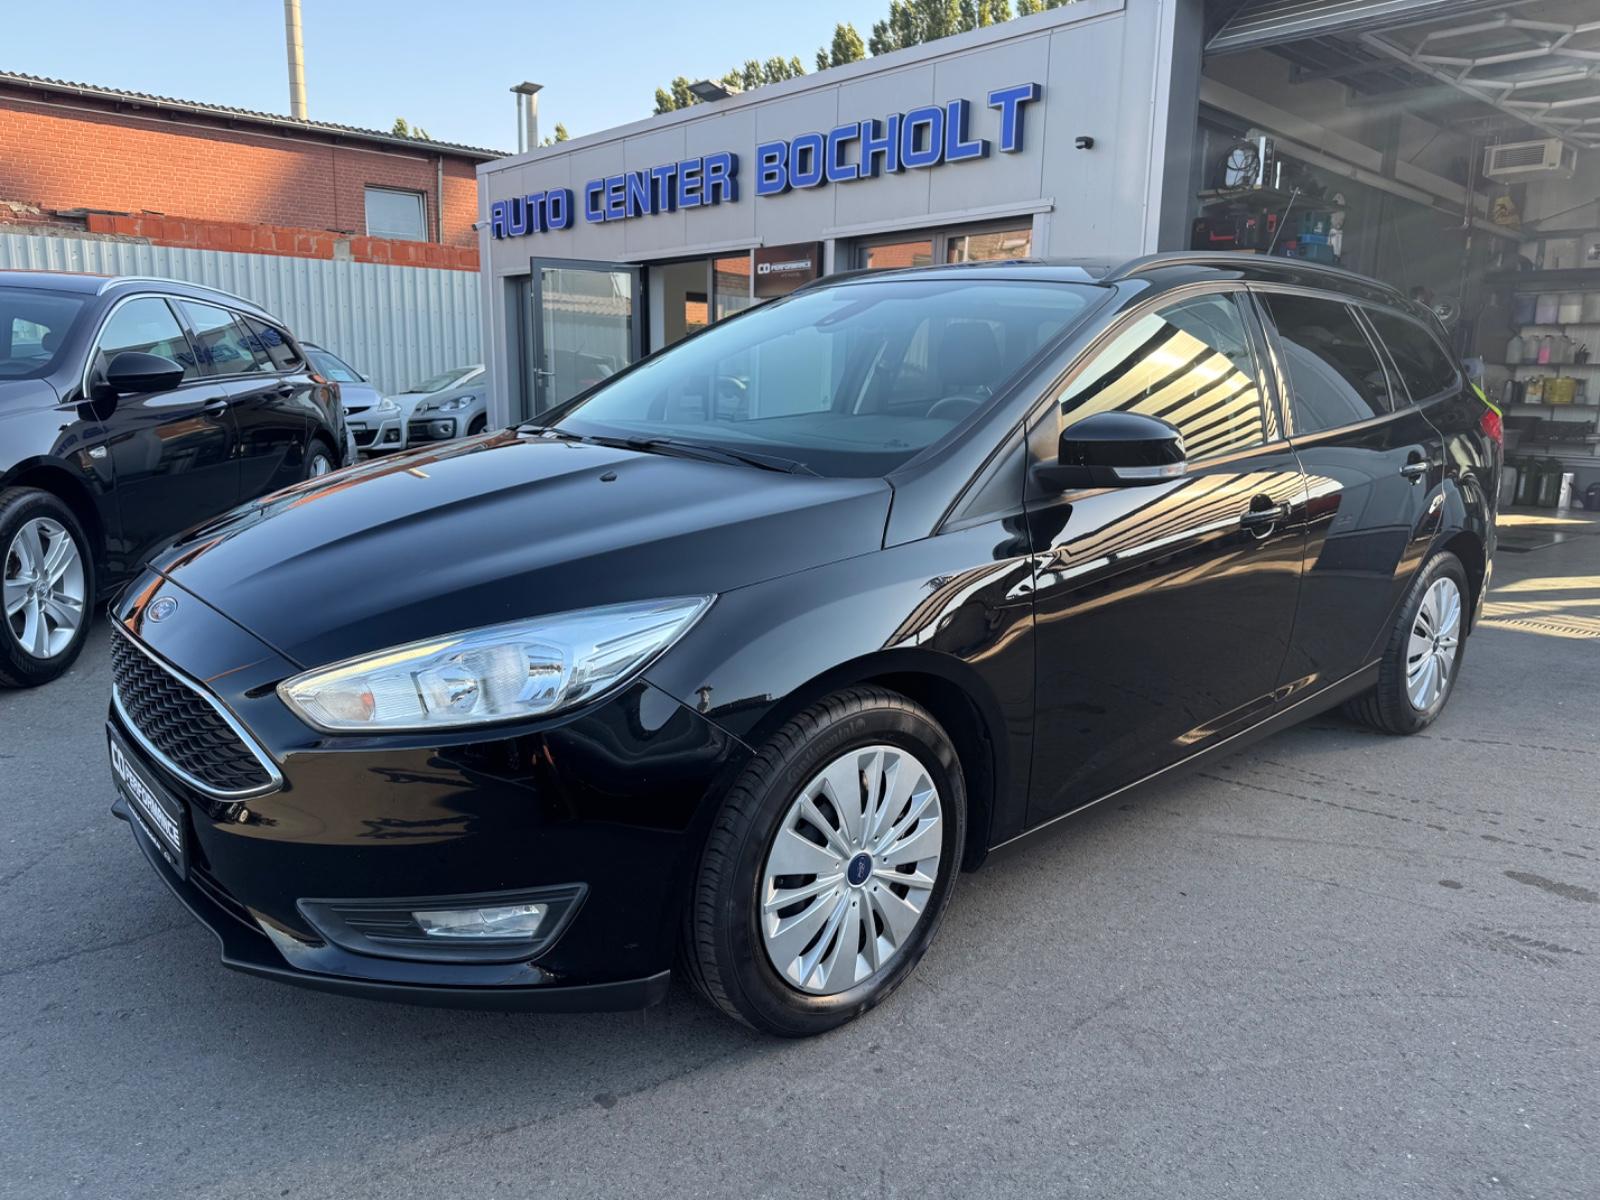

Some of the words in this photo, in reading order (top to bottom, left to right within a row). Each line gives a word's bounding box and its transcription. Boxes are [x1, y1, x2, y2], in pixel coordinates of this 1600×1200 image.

[491, 187, 574, 240] AUTO
[584, 151, 740, 225] CENTER
[755, 82, 1041, 197] BOCHOLT
[125, 768, 180, 847] PERFORMANCE
